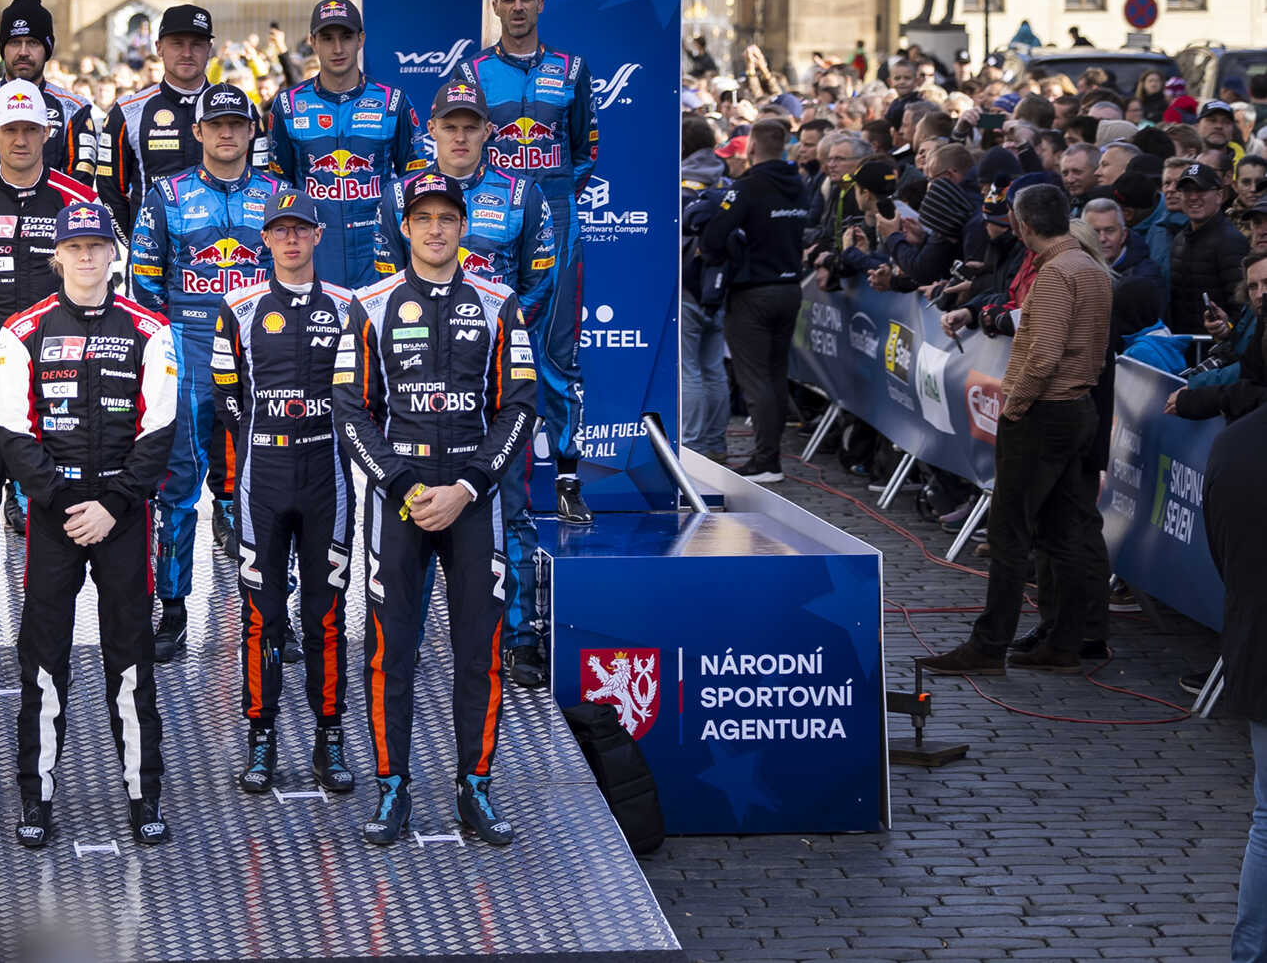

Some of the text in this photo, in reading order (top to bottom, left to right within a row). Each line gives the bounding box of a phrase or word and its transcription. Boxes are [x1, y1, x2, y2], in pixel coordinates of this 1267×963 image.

[209, 92, 242, 106] Ford
[487, 144, 561, 170] Red Bull
[305, 175, 382, 201] Red Bull
[580, 225, 649, 235] Software Company
[183, 269, 225, 294] Red
[236, 302, 255, 315] OMP
[449, 318, 487, 327] HYUNDAI
[90, 336, 134, 345] TOYOTA
[42, 345, 83, 361] GR
[41, 369, 78, 380] DENSO
[255, 389, 305, 399] HYUNDAI
[397, 381, 446, 393] HYUNDAI
[267, 398, 333, 420] MOBIS
[410, 392, 477, 413] MOBIS
[503, 412, 528, 456] HYUNDAI
[585, 422, 648, 440] EAN FUELS
[353, 439, 386, 481] HYUNDAI
[700, 646, 824, 676] NÁRODNÍ
[700, 678, 854, 709] SPORTOVNÍ
[700, 717, 847, 741] AGENTURA
